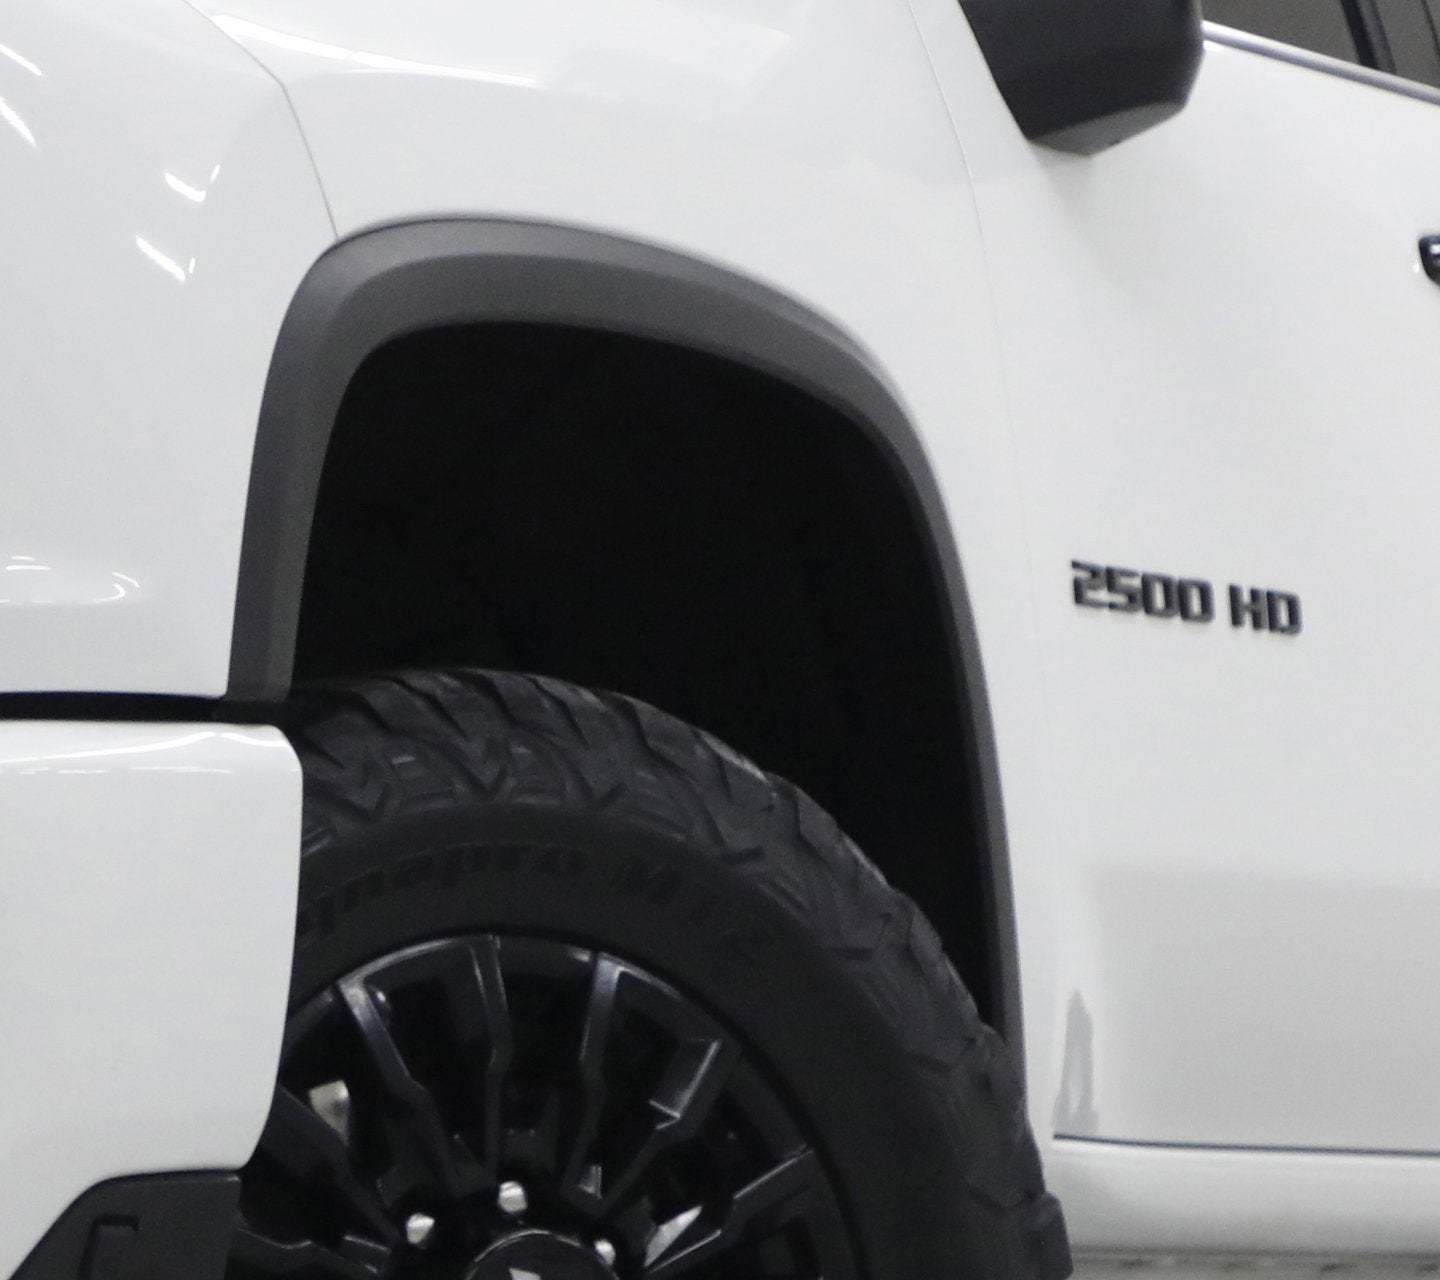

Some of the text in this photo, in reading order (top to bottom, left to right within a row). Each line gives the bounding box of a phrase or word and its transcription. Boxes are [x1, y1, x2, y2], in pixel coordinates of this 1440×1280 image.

[1070, 559, 1303, 636] 2500 HD
[296, 840, 590, 938] ynapro
